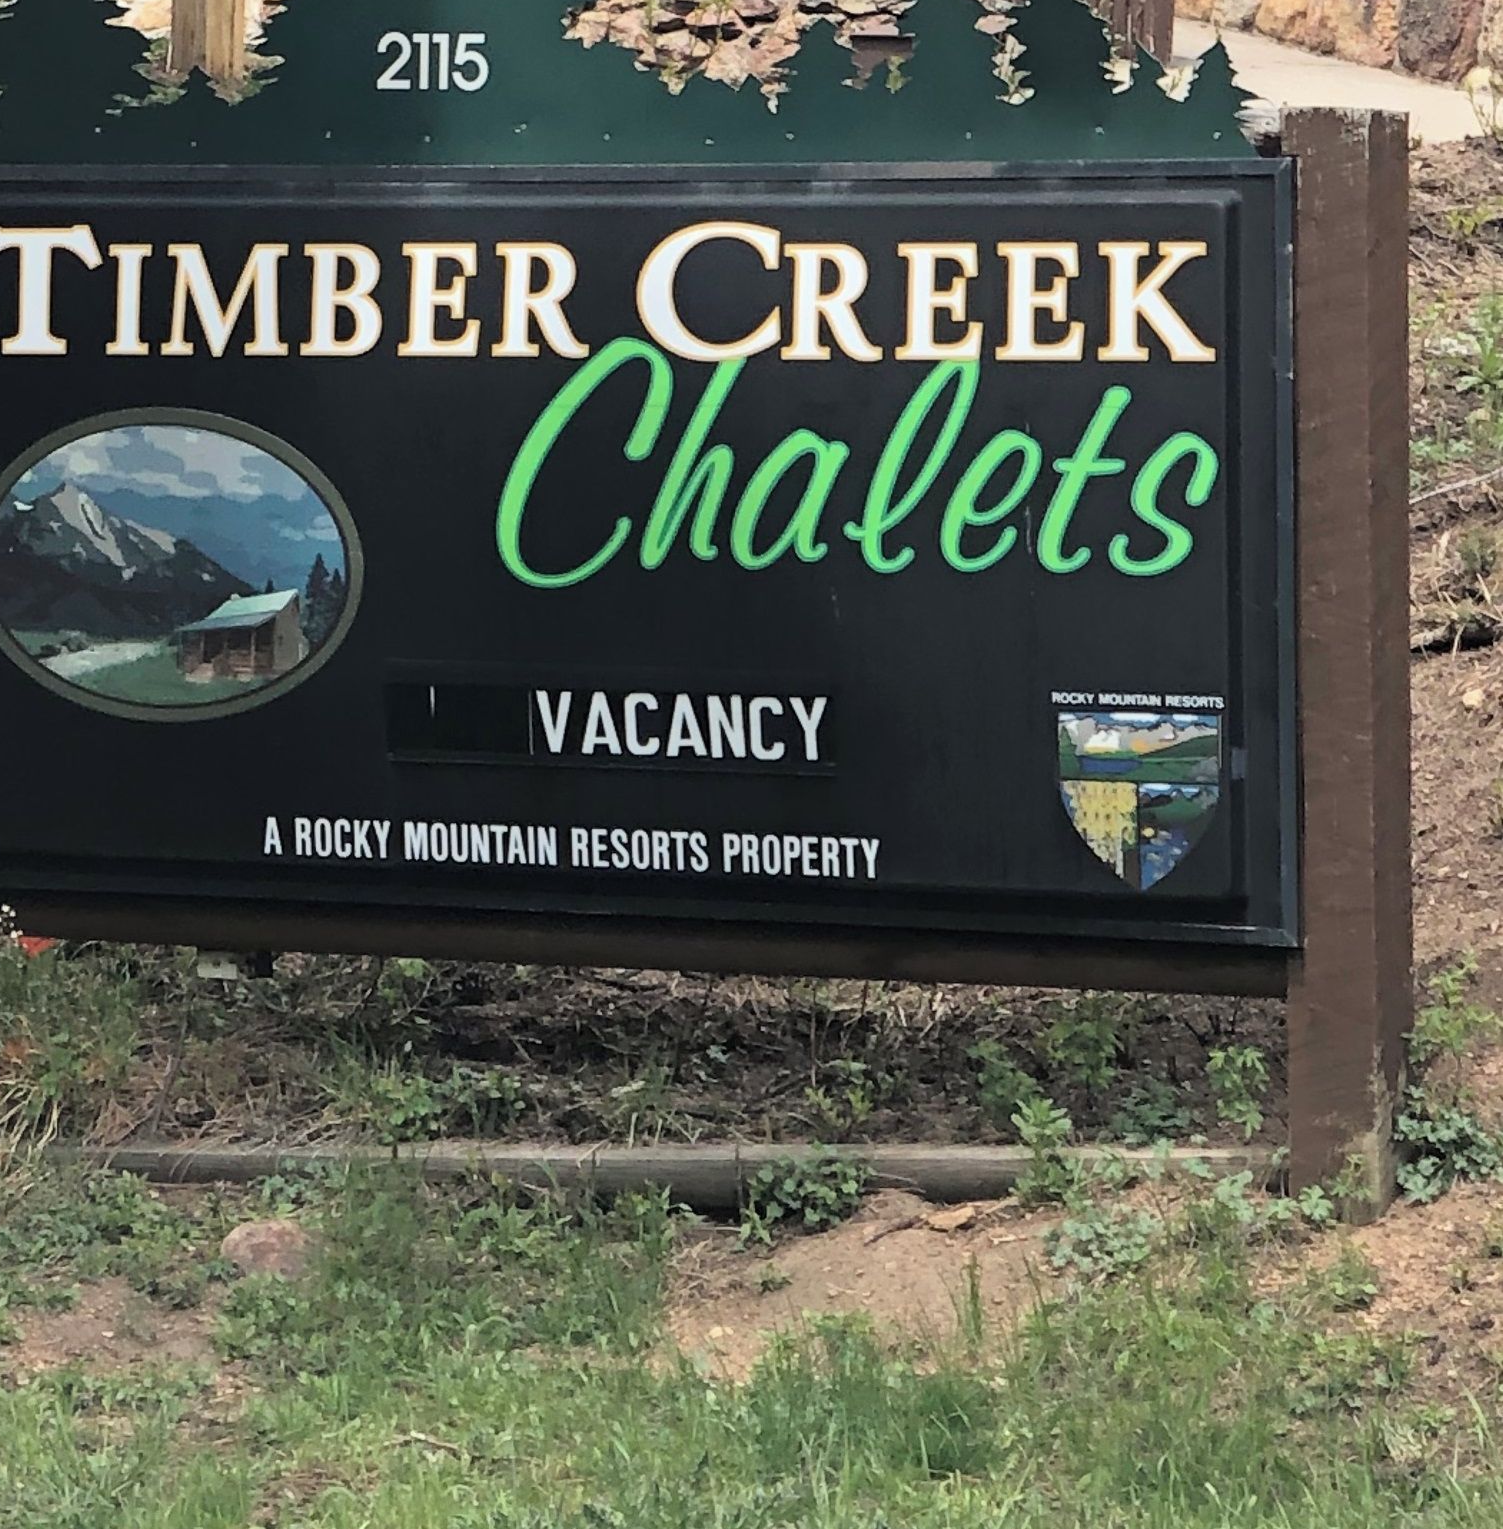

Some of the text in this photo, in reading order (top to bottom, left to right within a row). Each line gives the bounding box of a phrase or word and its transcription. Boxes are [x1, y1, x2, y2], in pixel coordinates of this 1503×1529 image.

[375, 30, 490, 92] 2115
[635, 221, 1217, 363] CREEK
[495, 336, 1219, 589] Chalets
[535, 689, 828, 761] VACANCY
[1051, 691, 1225, 709] ROCKY MOUNTAIN RESORTS
[263, 816, 881, 880] A ROCKY MOUNTAIN RESORTS PROPERTY
